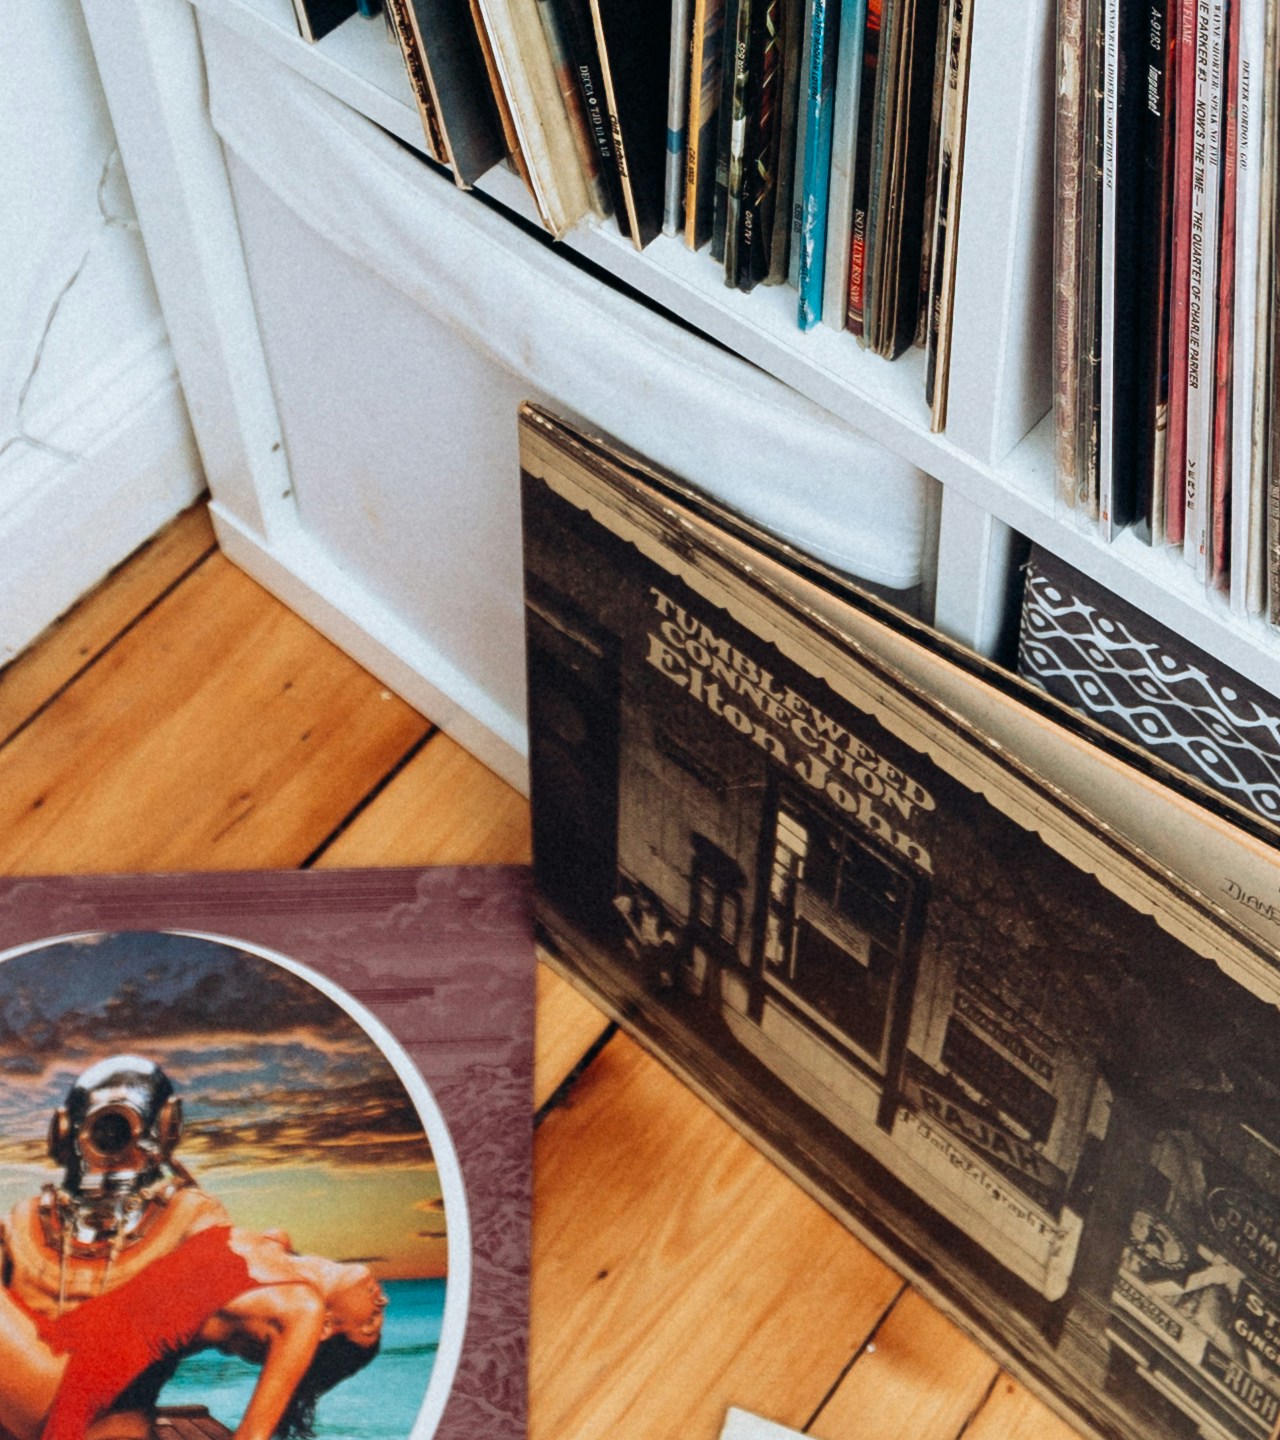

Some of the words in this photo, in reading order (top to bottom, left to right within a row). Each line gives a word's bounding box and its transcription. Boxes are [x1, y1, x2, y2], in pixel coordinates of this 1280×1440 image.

[1149, 6, 1163, 51] A-9183
[1181, 5, 1192, 46] FLAME
[1196, 16, 1209, 67] PARKER
[579, 65, 594, 96] DECCA
[590, 106, 602, 125] TJD
[1240, 59, 1251, 101] DEXTER
[1194, 99, 1207, 137] NOW'S
[1194, 141, 1206, 164] THE
[1193, 165, 1205, 192] TIME
[1191, 210, 1204, 232] THE
[851, 229, 864, 265] DELUXE
[1190, 233, 1203, 283] QUARTET
[1189, 284, 1201, 301] OF
[1188, 301, 1201, 346] CHARLIE
[1187, 347, 1200, 389] PARKER
[649, 585, 937, 812] TUMBLEWEED
[660, 621, 918, 820] CONNECTION
[645, 631, 790, 767] Elton
[794, 753, 935, 876] John
